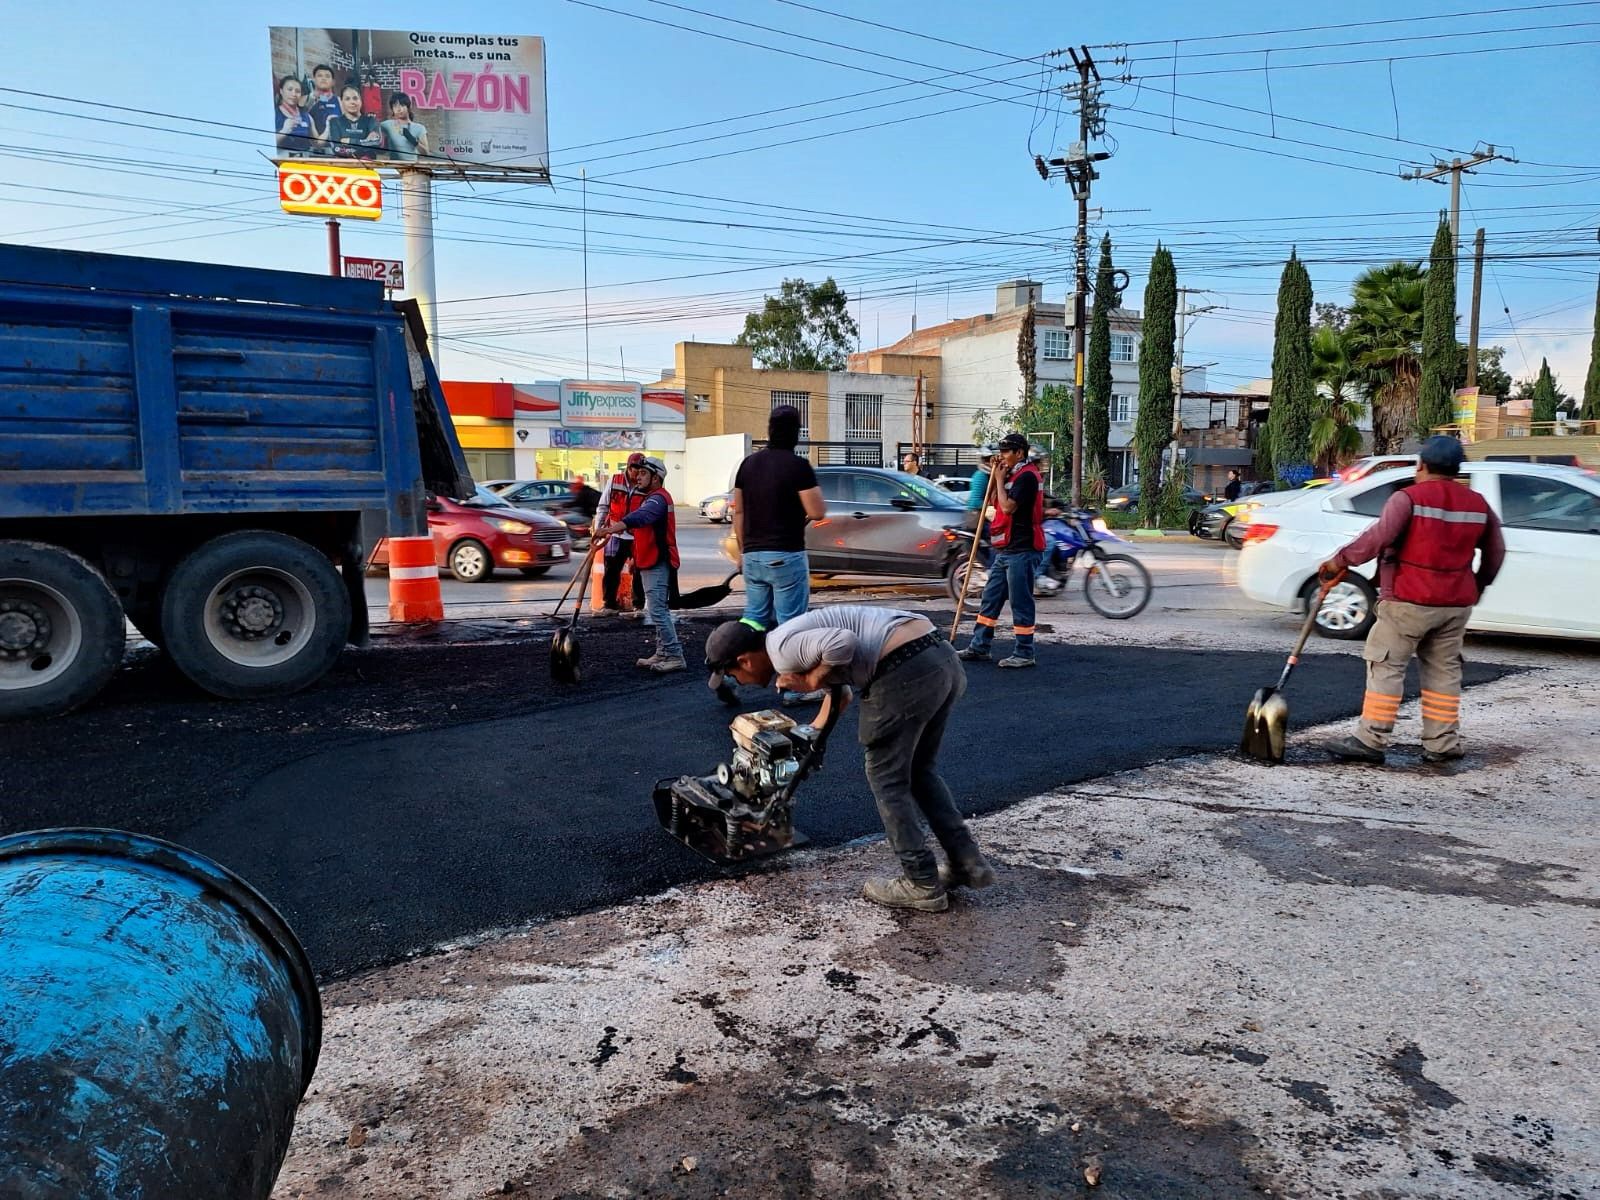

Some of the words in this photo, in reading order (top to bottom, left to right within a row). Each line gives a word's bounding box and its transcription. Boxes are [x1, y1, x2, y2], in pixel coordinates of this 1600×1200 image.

[409, 32, 436, 45] Que
[438, 34, 494, 48] cumplas
[497, 36, 519, 47] tus
[413, 48, 466, 60] metas...
[468, 50, 483, 60] es
[486, 51, 511, 61] una
[400, 63, 531, 113] RAZÓN
[456, 136, 473, 146] Luis
[283, 174, 378, 206] OXXO
[346, 263, 373, 281] ABIERTO
